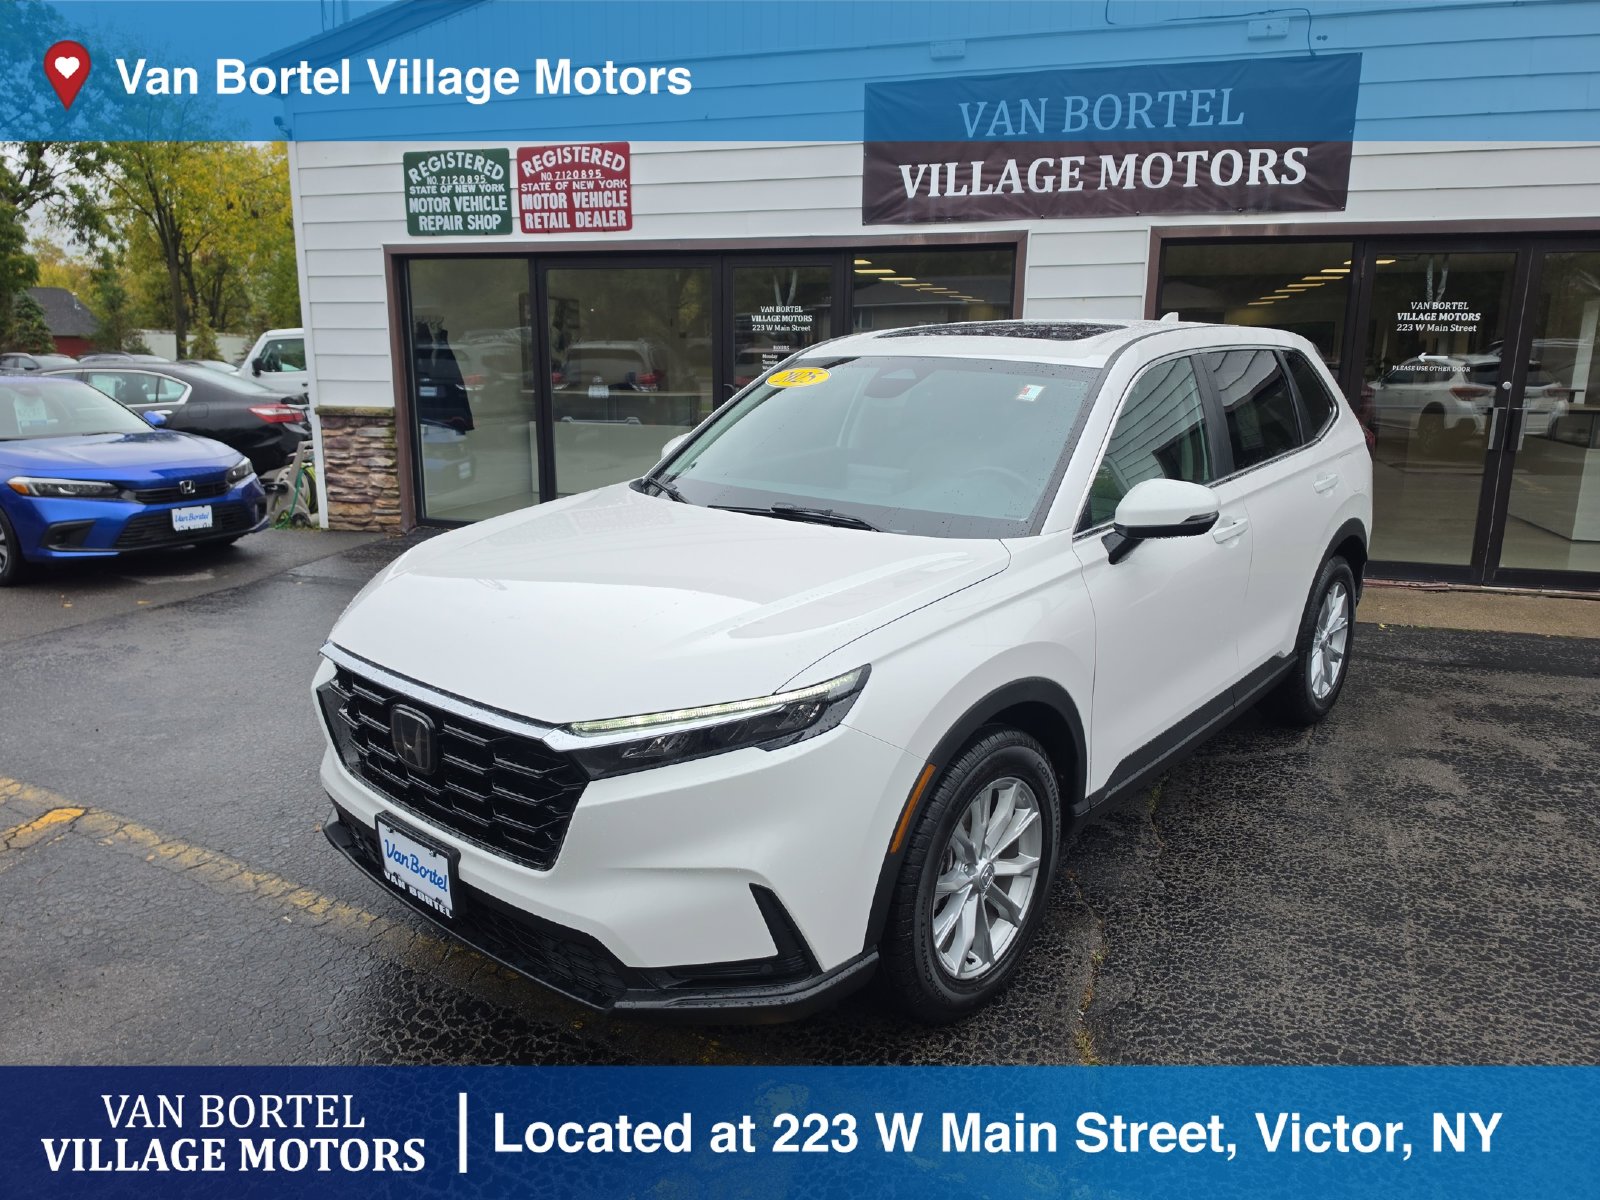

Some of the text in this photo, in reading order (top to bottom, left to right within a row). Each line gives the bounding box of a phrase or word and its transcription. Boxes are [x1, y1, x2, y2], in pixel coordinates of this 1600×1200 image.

[958, 87, 1245, 139] VAN BORTEL
[408, 151, 504, 185] REGISTERED
[521, 146, 626, 178] REGISTERED
[440, 174, 487, 185] 7120895
[554, 170, 602, 180] 7120895
[898, 146, 1309, 199] VILLAGE MOTORS
[409, 184, 505, 194] STATE OF NEW YORK
[521, 179, 628, 192] STATE OF NEW YORK
[409, 195, 508, 213] MOTOR VEHICLE
[521, 190, 628, 210] MOTOR VEHICLE
[418, 213, 502, 231] REPAIR SHOP
[524, 210, 627, 230] RETAIL DEALER
[1410, 302, 1469, 310] VAN BORTEL
[1397, 313, 1481, 321] VILLAGE MOTORS
[792, 324, 811, 332] Street
[1450, 324, 1477, 332] Street
[383, 868, 406, 890] VAN
